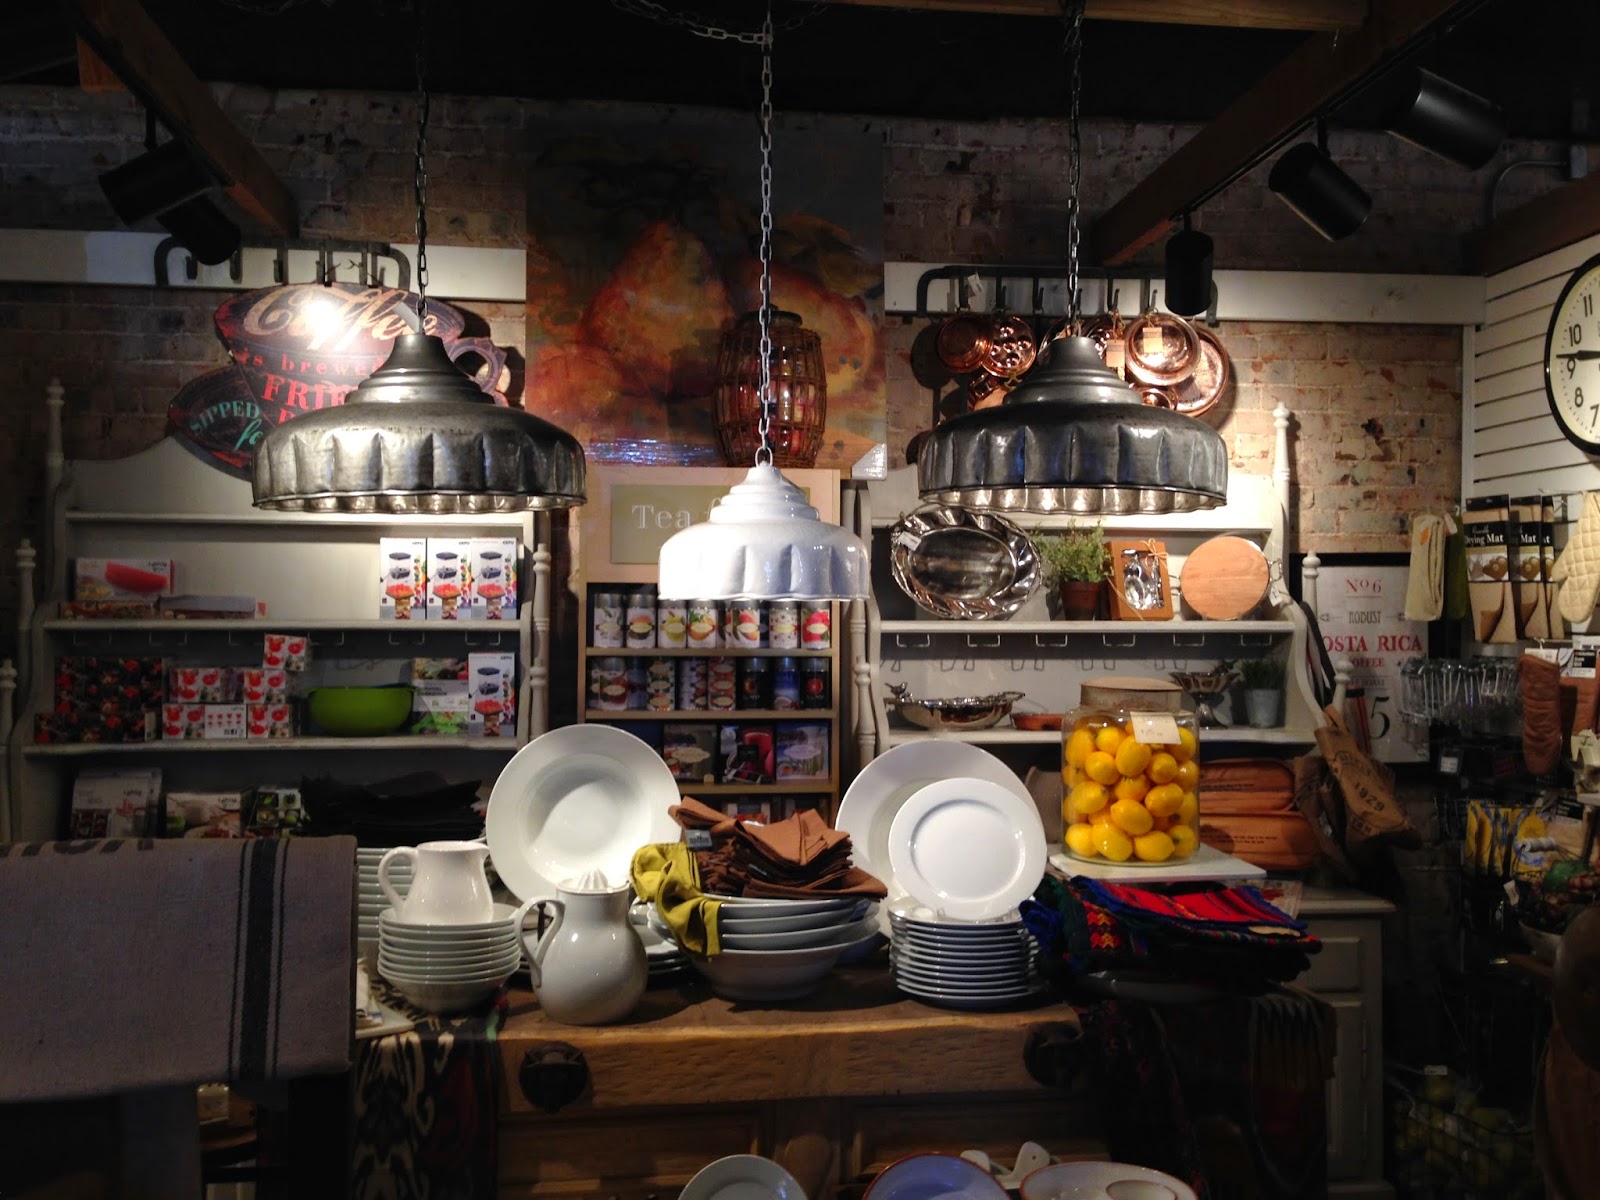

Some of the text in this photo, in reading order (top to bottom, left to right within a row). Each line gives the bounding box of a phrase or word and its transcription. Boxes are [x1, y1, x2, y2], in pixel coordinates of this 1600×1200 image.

[1583, 294, 1593, 317] 11
[1569, 323, 1582, 346] 10
[1567, 357, 1576, 379] 9
[261, 372, 358, 410] FRIE
[1574, 387, 1584, 407] 8
[190, 401, 260, 430] SIPPED
[1590, 404, 1599, 427] 7
[631, 504, 691, 529] Tea
[1486, 533, 1504, 544] Mat
[1520, 534, 1537, 544] Mat
[1348, 610, 1382, 624] ROBUST
[1322, 635, 1423, 652] OSTA RICA
[1351, 657, 1385, 668] OFFEE
